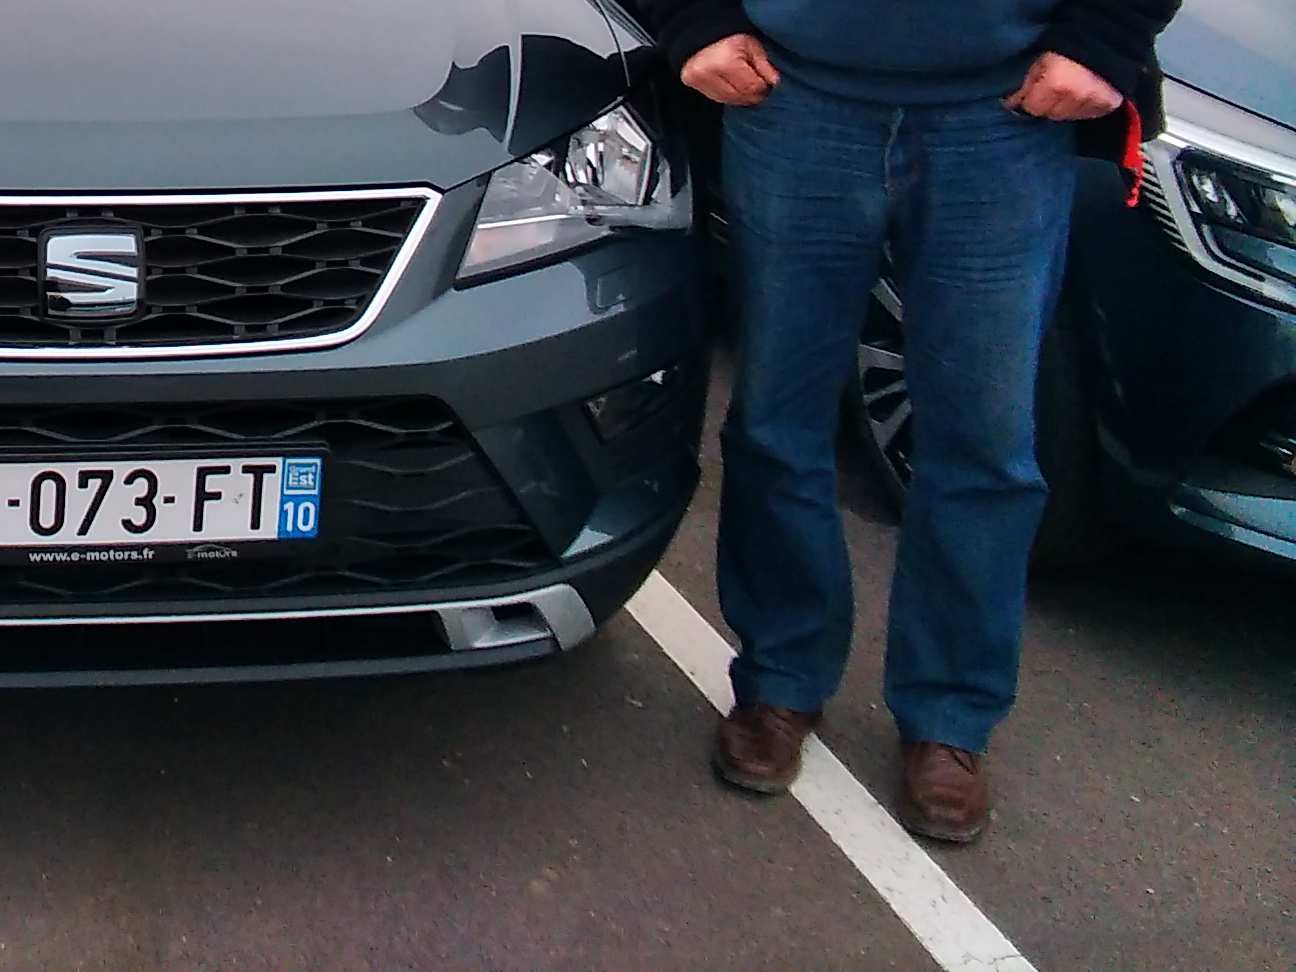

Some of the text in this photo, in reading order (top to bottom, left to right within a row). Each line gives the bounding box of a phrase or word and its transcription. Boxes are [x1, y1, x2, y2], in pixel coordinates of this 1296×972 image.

[288, 472, 315, 488] Est
[283, 501, 316, 533] 10
[27, 548, 156, 563] www.e-motors.fr
